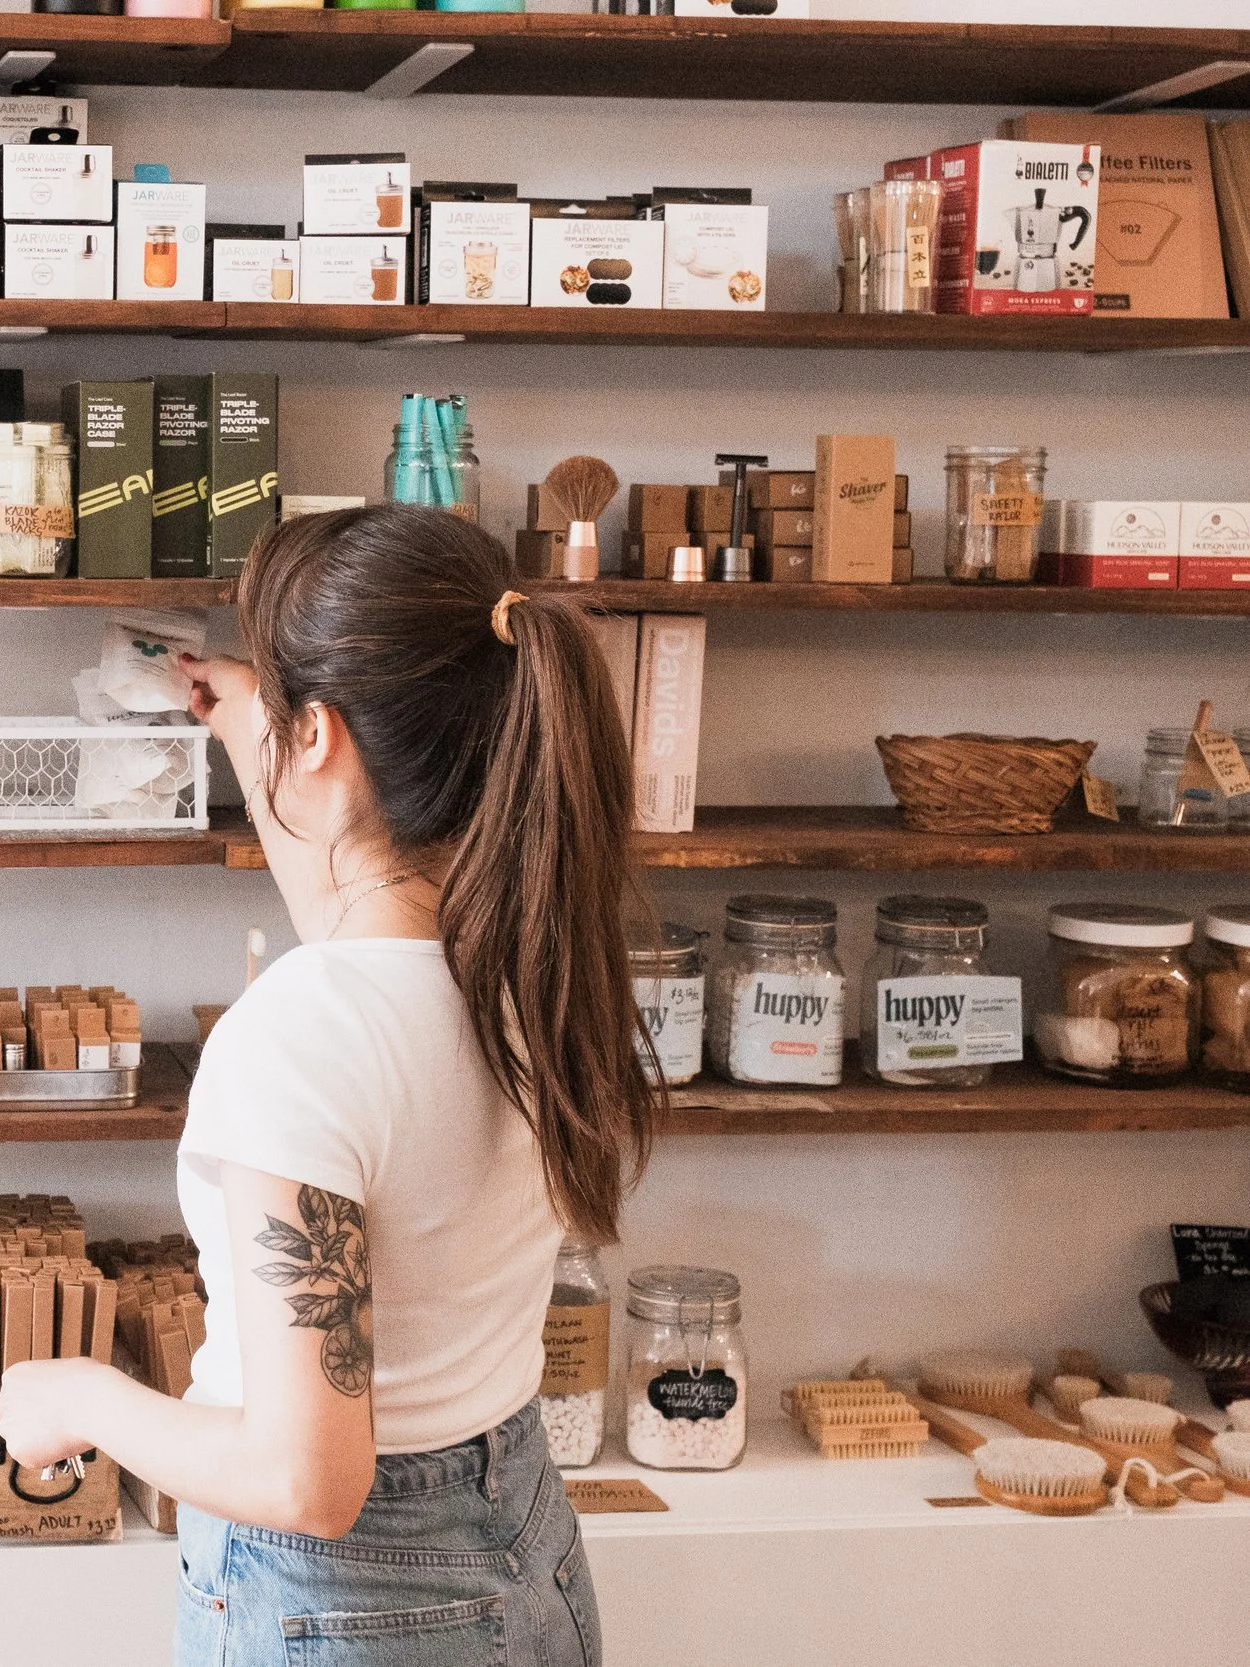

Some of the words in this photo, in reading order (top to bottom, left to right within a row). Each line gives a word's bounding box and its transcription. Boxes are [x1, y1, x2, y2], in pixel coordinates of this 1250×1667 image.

[10, 152, 74, 163] JARWARE
[1100, 156, 1133, 170] ffee
[1139, 155, 1192, 171] Filters
[133, 190, 188, 201] JARWARE
[447, 211, 514, 224] JARWARE
[564, 223, 631, 235] JARWARE
[1120, 224, 1142, 235] #02
[13, 233, 74, 244] JARWARE
[220, 400, 259, 408] TRIPLE-
[87, 413, 123, 421] BLADE
[160, 412, 194, 420] BLADE
[87, 430, 116, 438] CASE
[839, 482, 886, 499] Shaver
[980, 497, 1023, 511] SAFETY
[989, 511, 1020, 521] RAZOR
[5, 517, 37, 528] BLADE
[652, 628, 690, 758] Davids
[754, 982, 828, 1027] huppy
[885, 987, 965, 1027] huppy
[38, 1515, 82, 1532] ADULT
